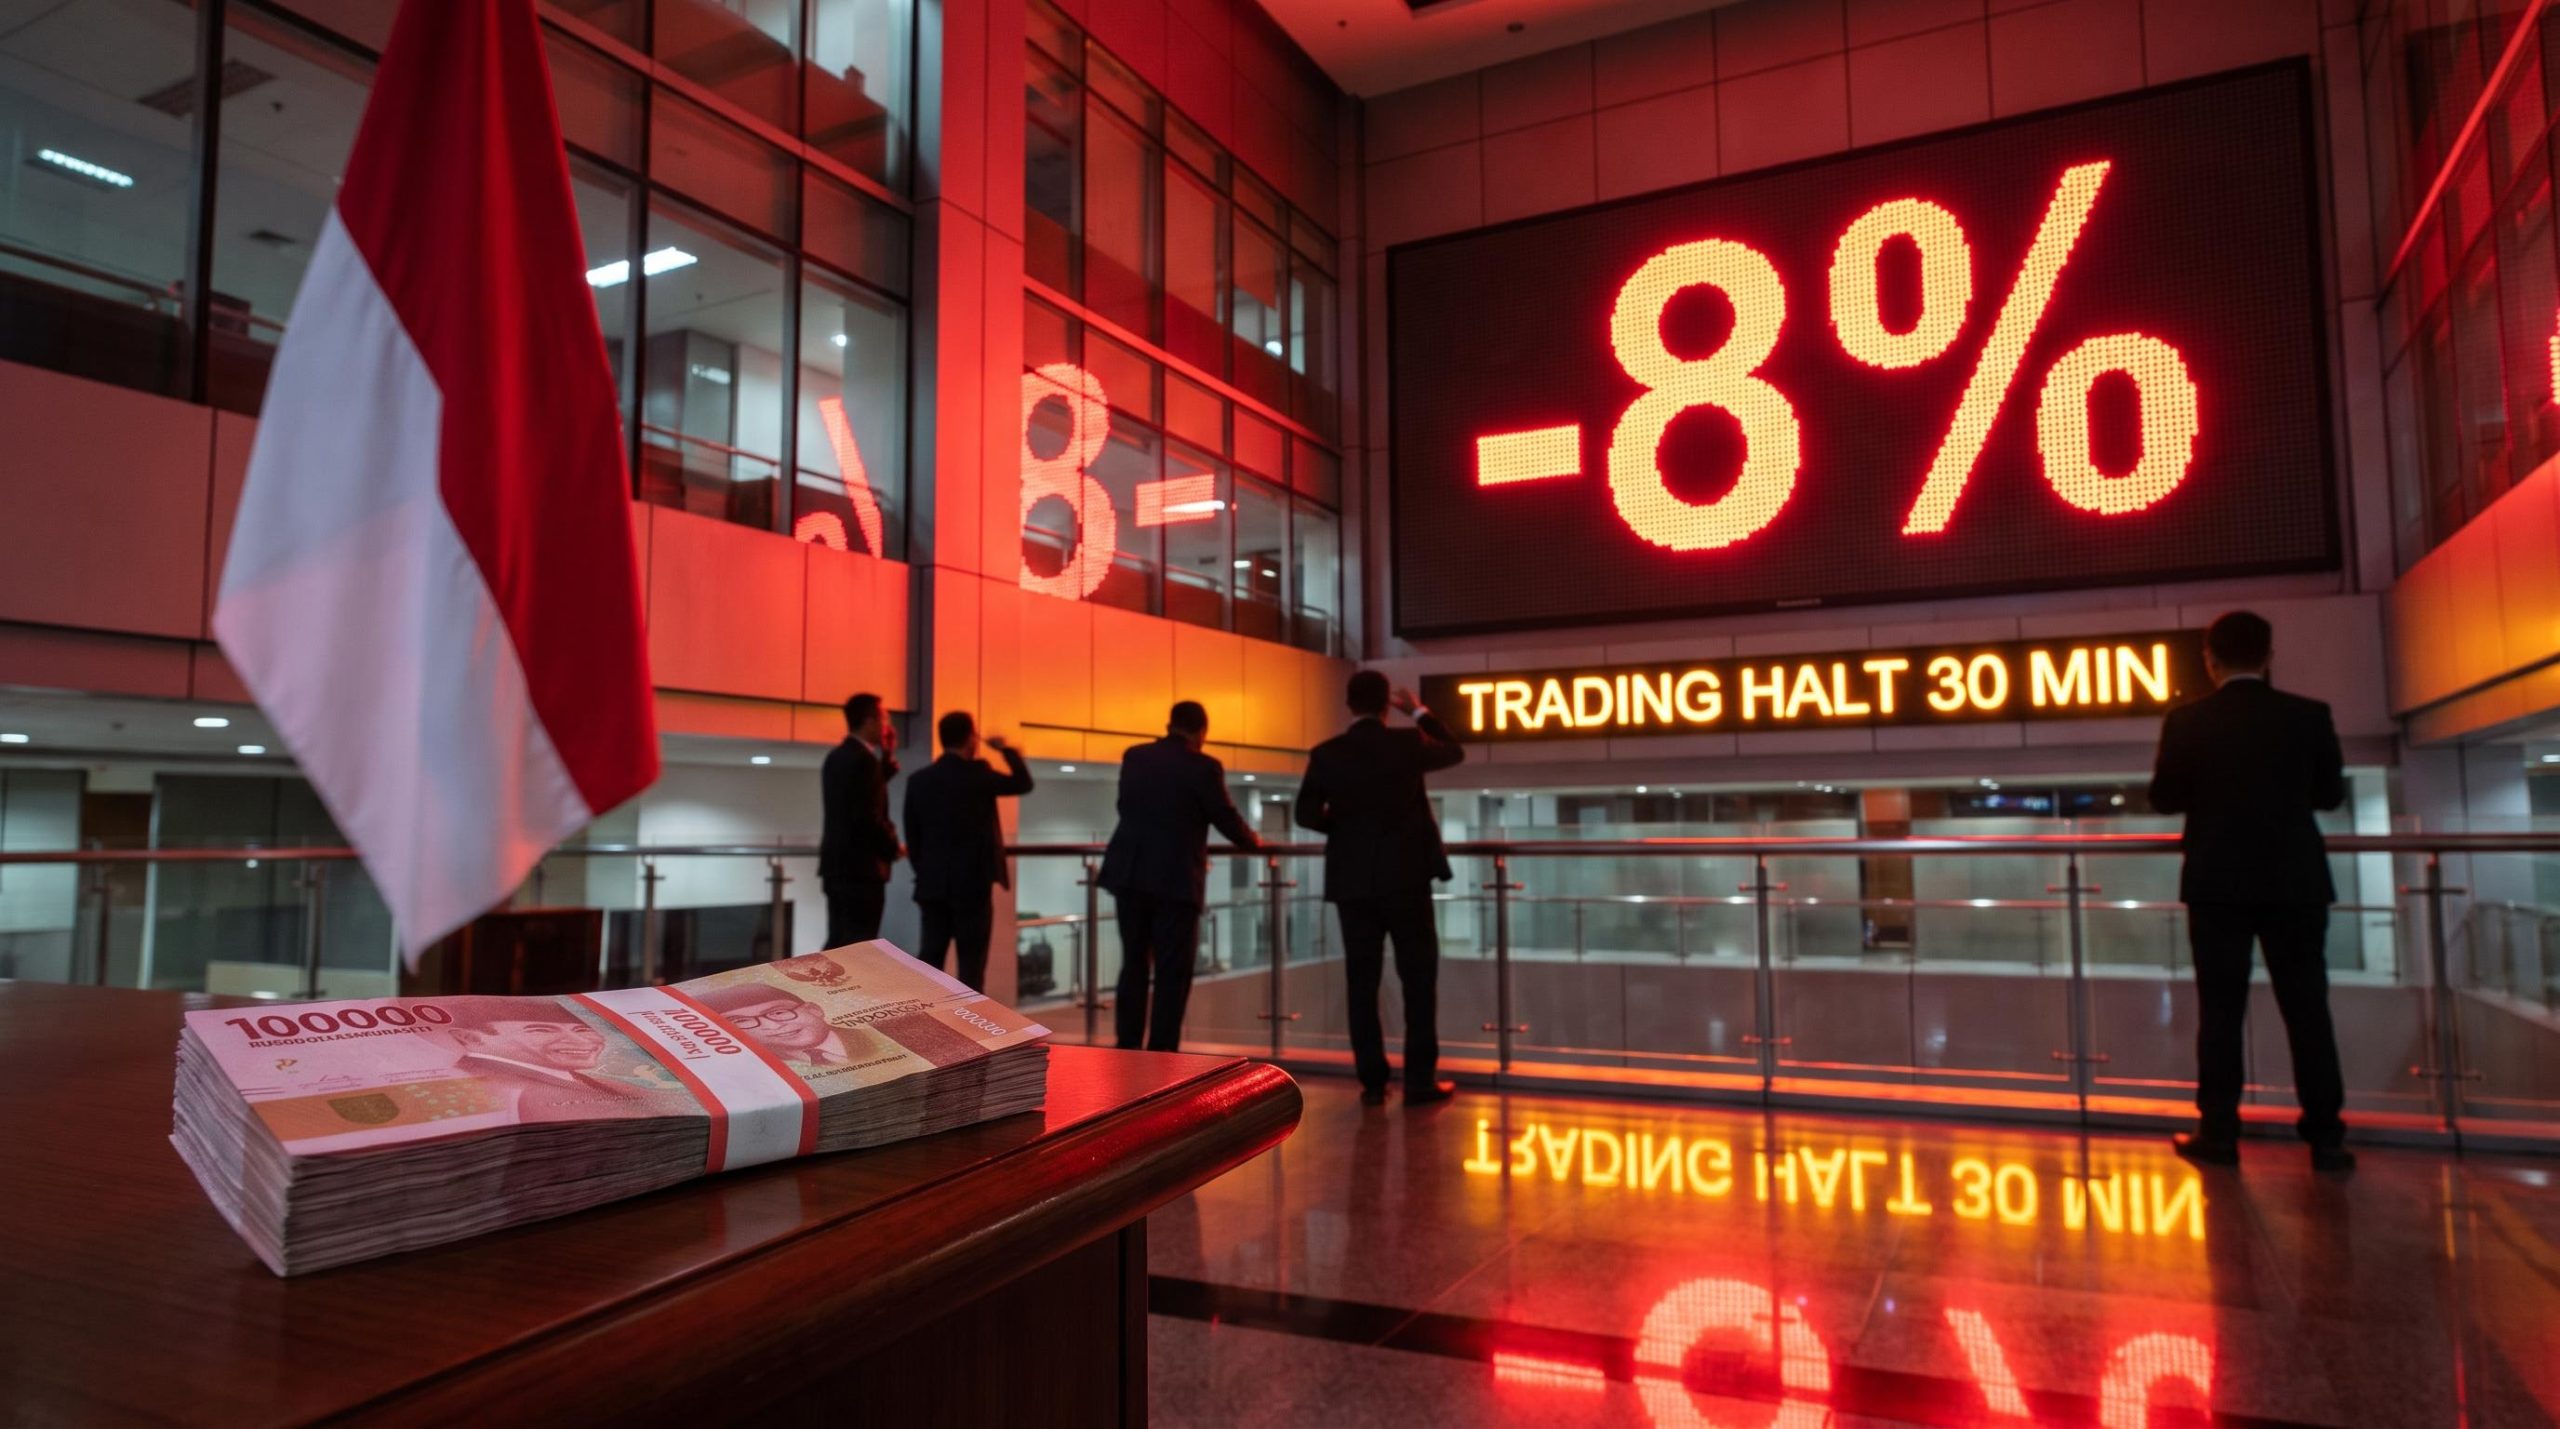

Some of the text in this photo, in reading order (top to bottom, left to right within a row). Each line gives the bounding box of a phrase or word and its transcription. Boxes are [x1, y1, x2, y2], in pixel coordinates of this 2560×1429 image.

[1475, 159, 2200, 553] -8%
[1456, 642, 2171, 733] TRADING HALT 30 MIN
[224, 1004, 453, 1041] 100000
[661, 1008, 742, 1055] 100000
